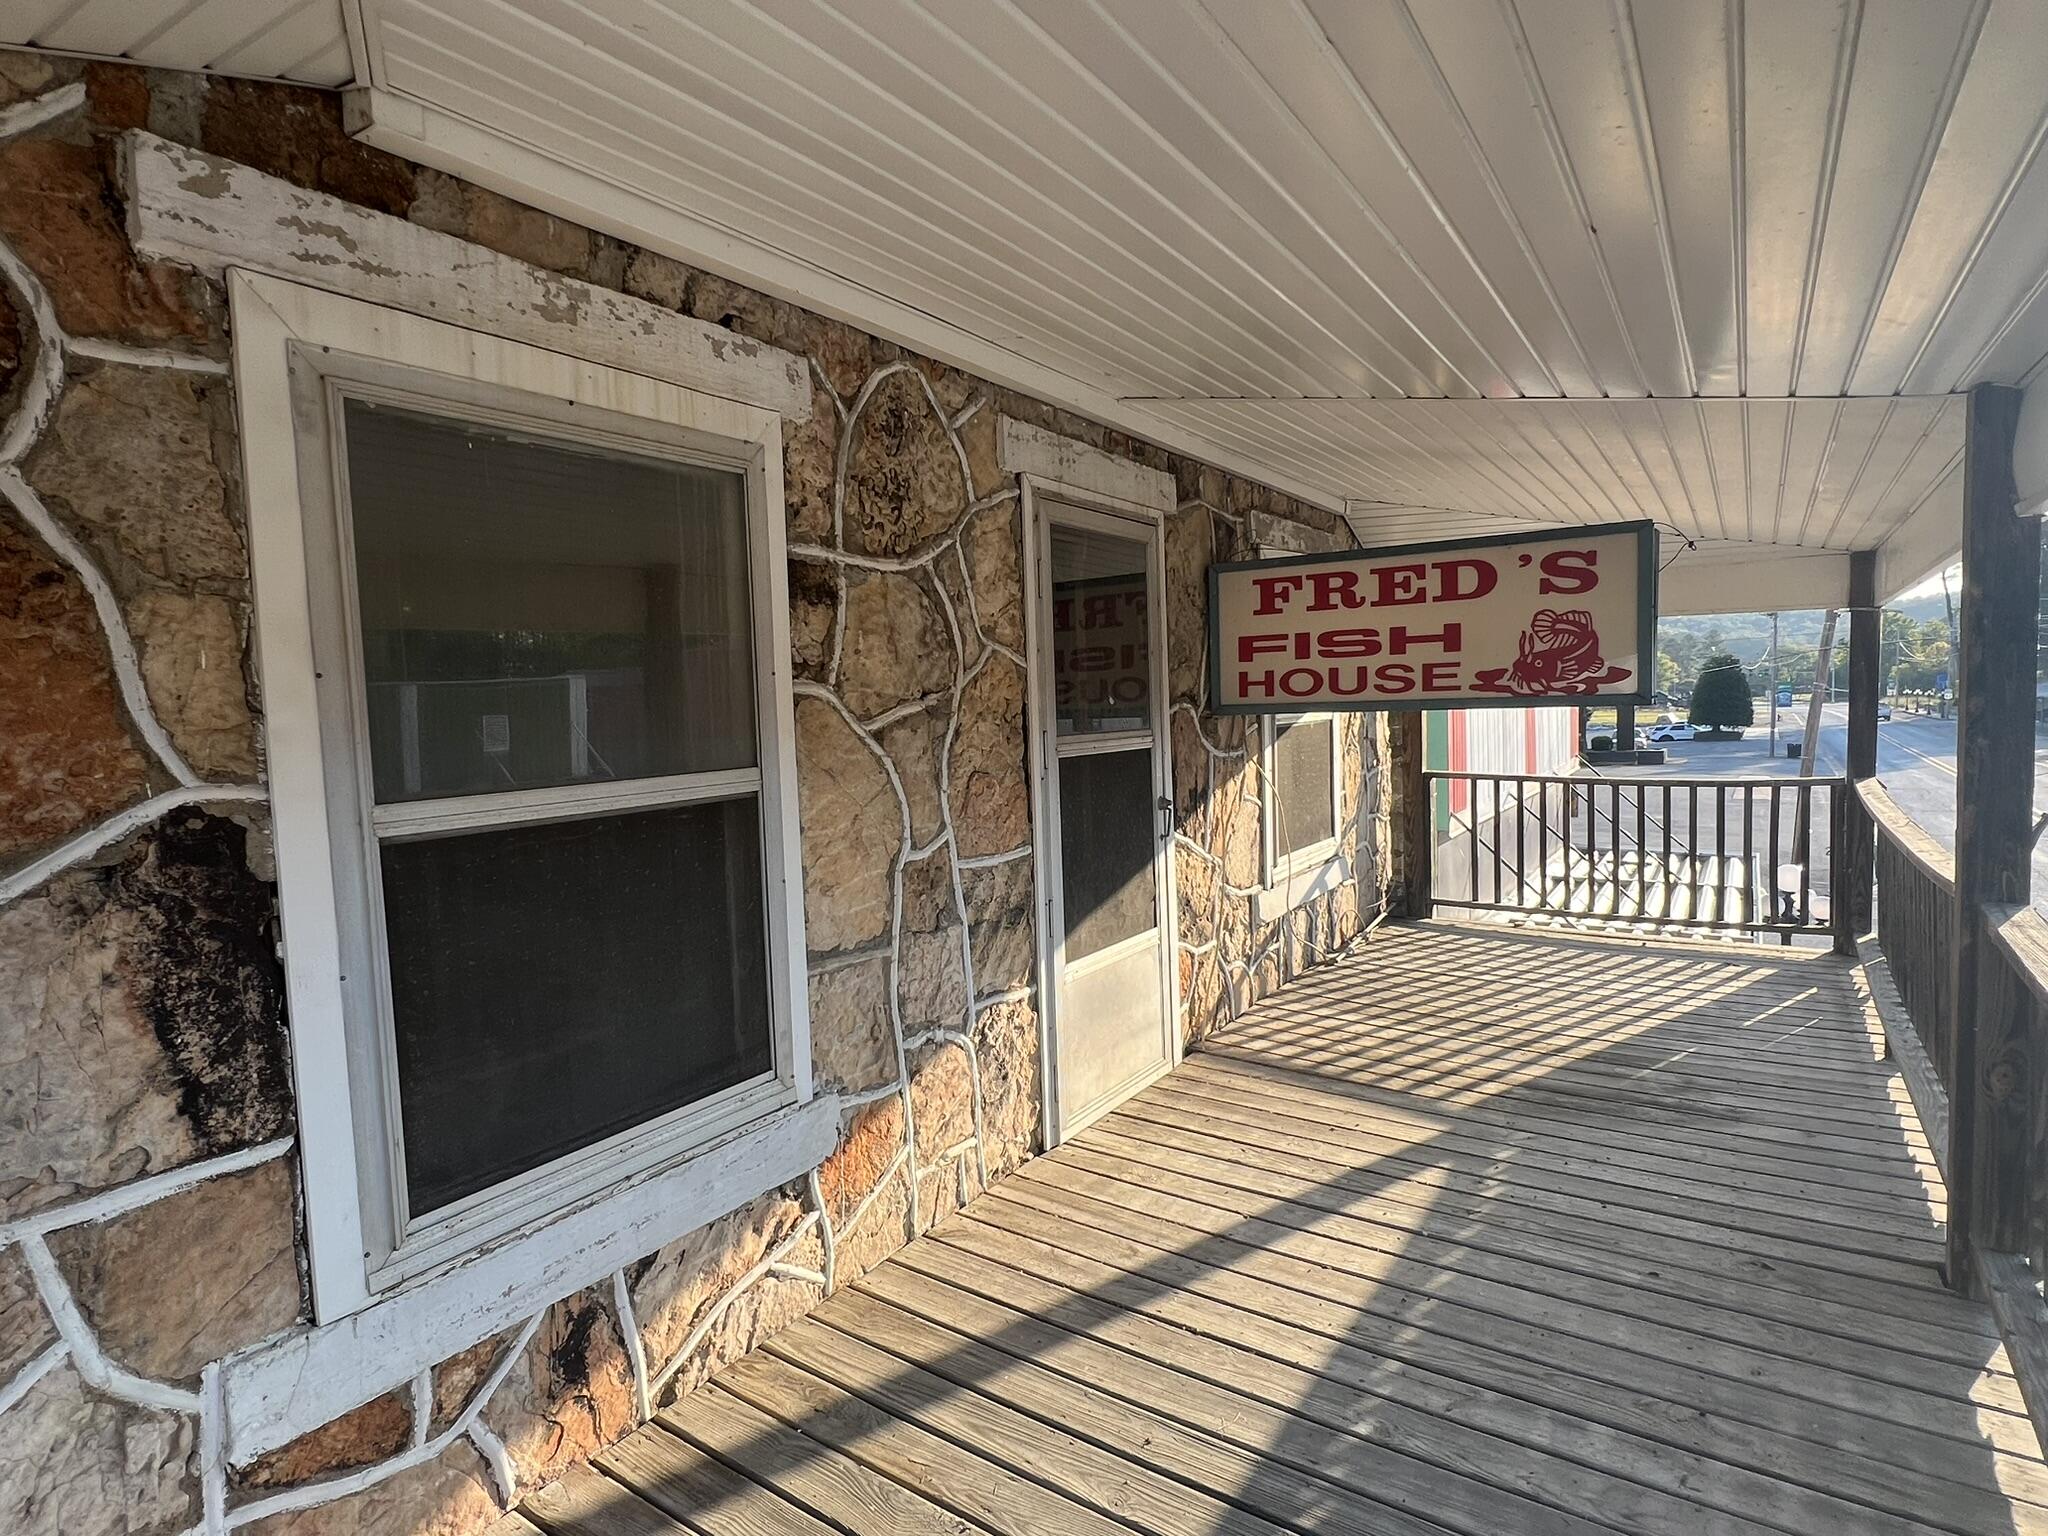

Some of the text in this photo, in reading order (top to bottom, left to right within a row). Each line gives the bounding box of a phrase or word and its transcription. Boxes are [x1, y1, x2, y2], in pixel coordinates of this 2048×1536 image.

[1252, 550, 1599, 615] FRED'S
[1238, 623, 1462, 662] FISH
[1238, 662, 1462, 698] HOUSE
